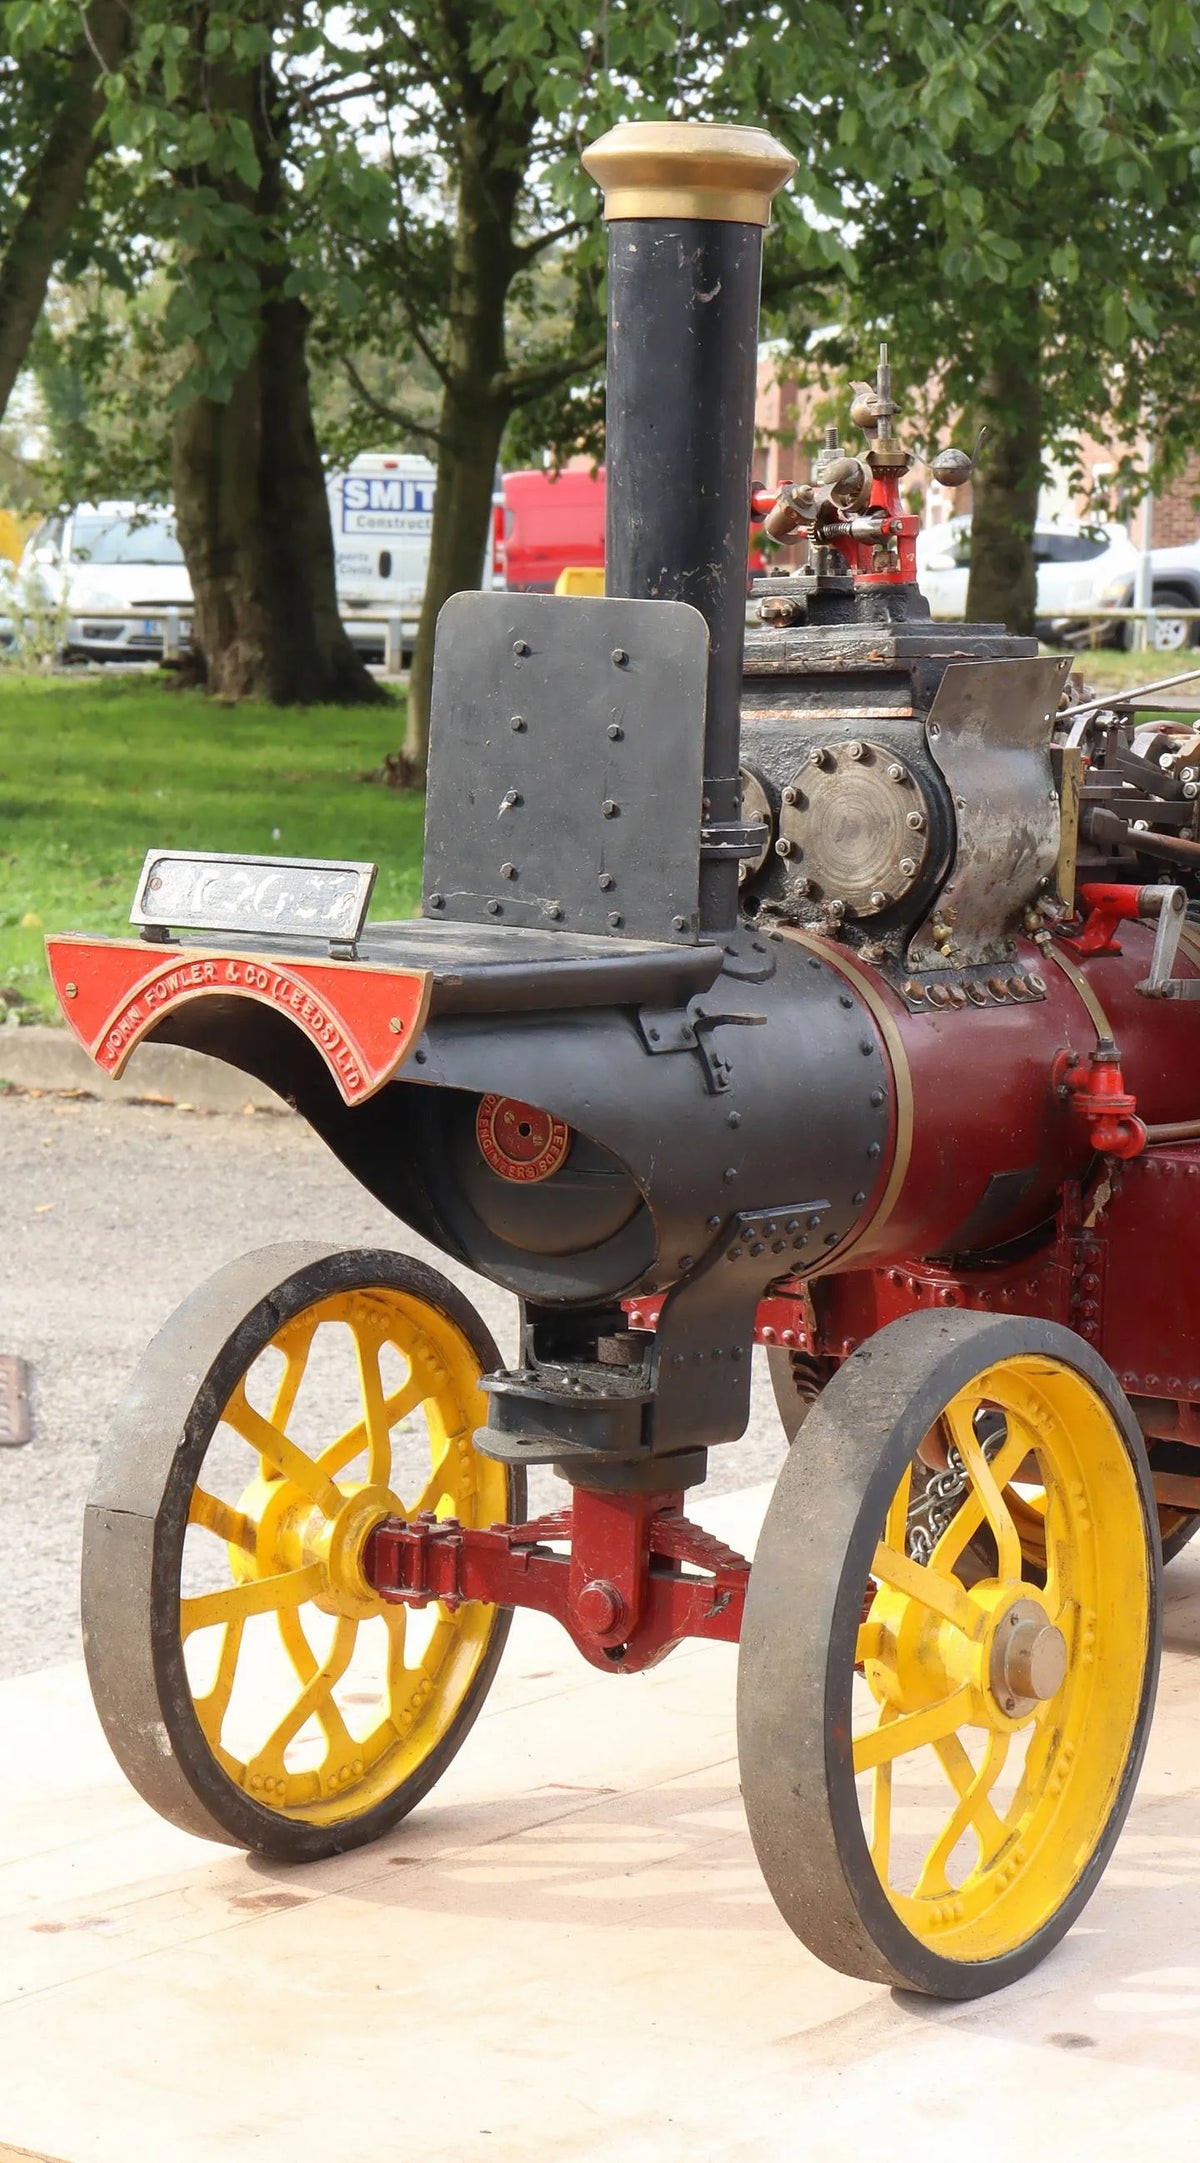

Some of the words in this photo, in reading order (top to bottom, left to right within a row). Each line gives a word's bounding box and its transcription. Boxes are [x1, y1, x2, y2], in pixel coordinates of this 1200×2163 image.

[105, 1005, 142, 1059] JOHN
[144, 962, 214, 1007] FOWLER
[225, 961, 241, 981] &
[245, 965, 268, 989] CO
[272, 977, 341, 1050] (LEEDS)
[336, 1047, 361, 1088] LTD
[539, 1125, 563, 1171] LEEDS
